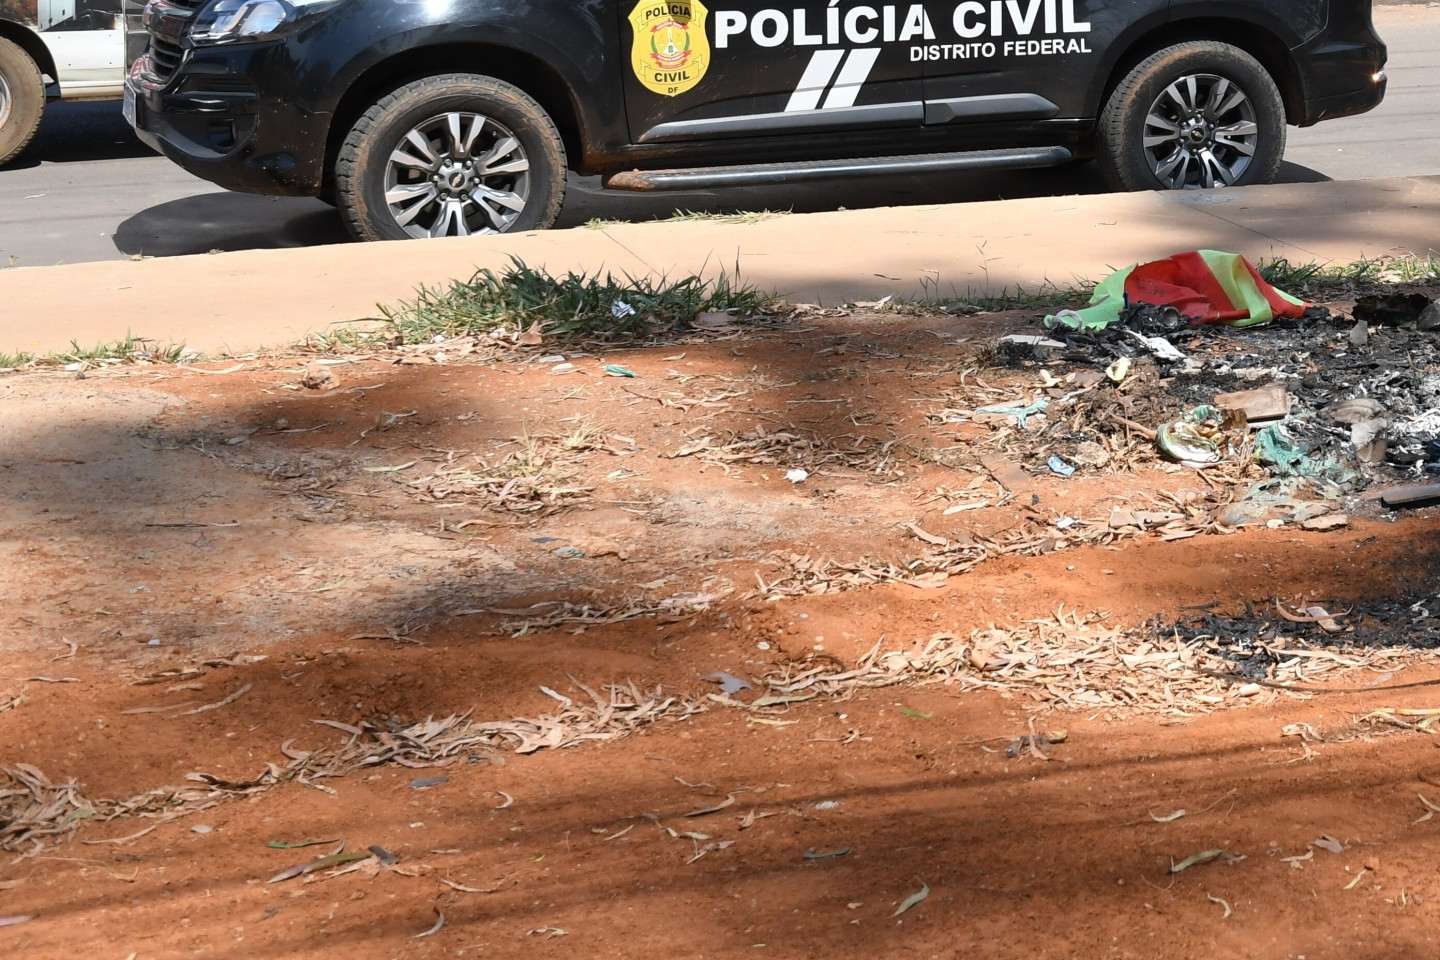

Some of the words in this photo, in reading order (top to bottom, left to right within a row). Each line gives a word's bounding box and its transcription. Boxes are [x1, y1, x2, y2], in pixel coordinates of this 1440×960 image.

[910, 42, 995, 62] DISTRITO
[1003, 38, 1092, 57] FEDERAL
[654, 71, 690, 83] CIVIL
[667, 86, 679, 94] DF
